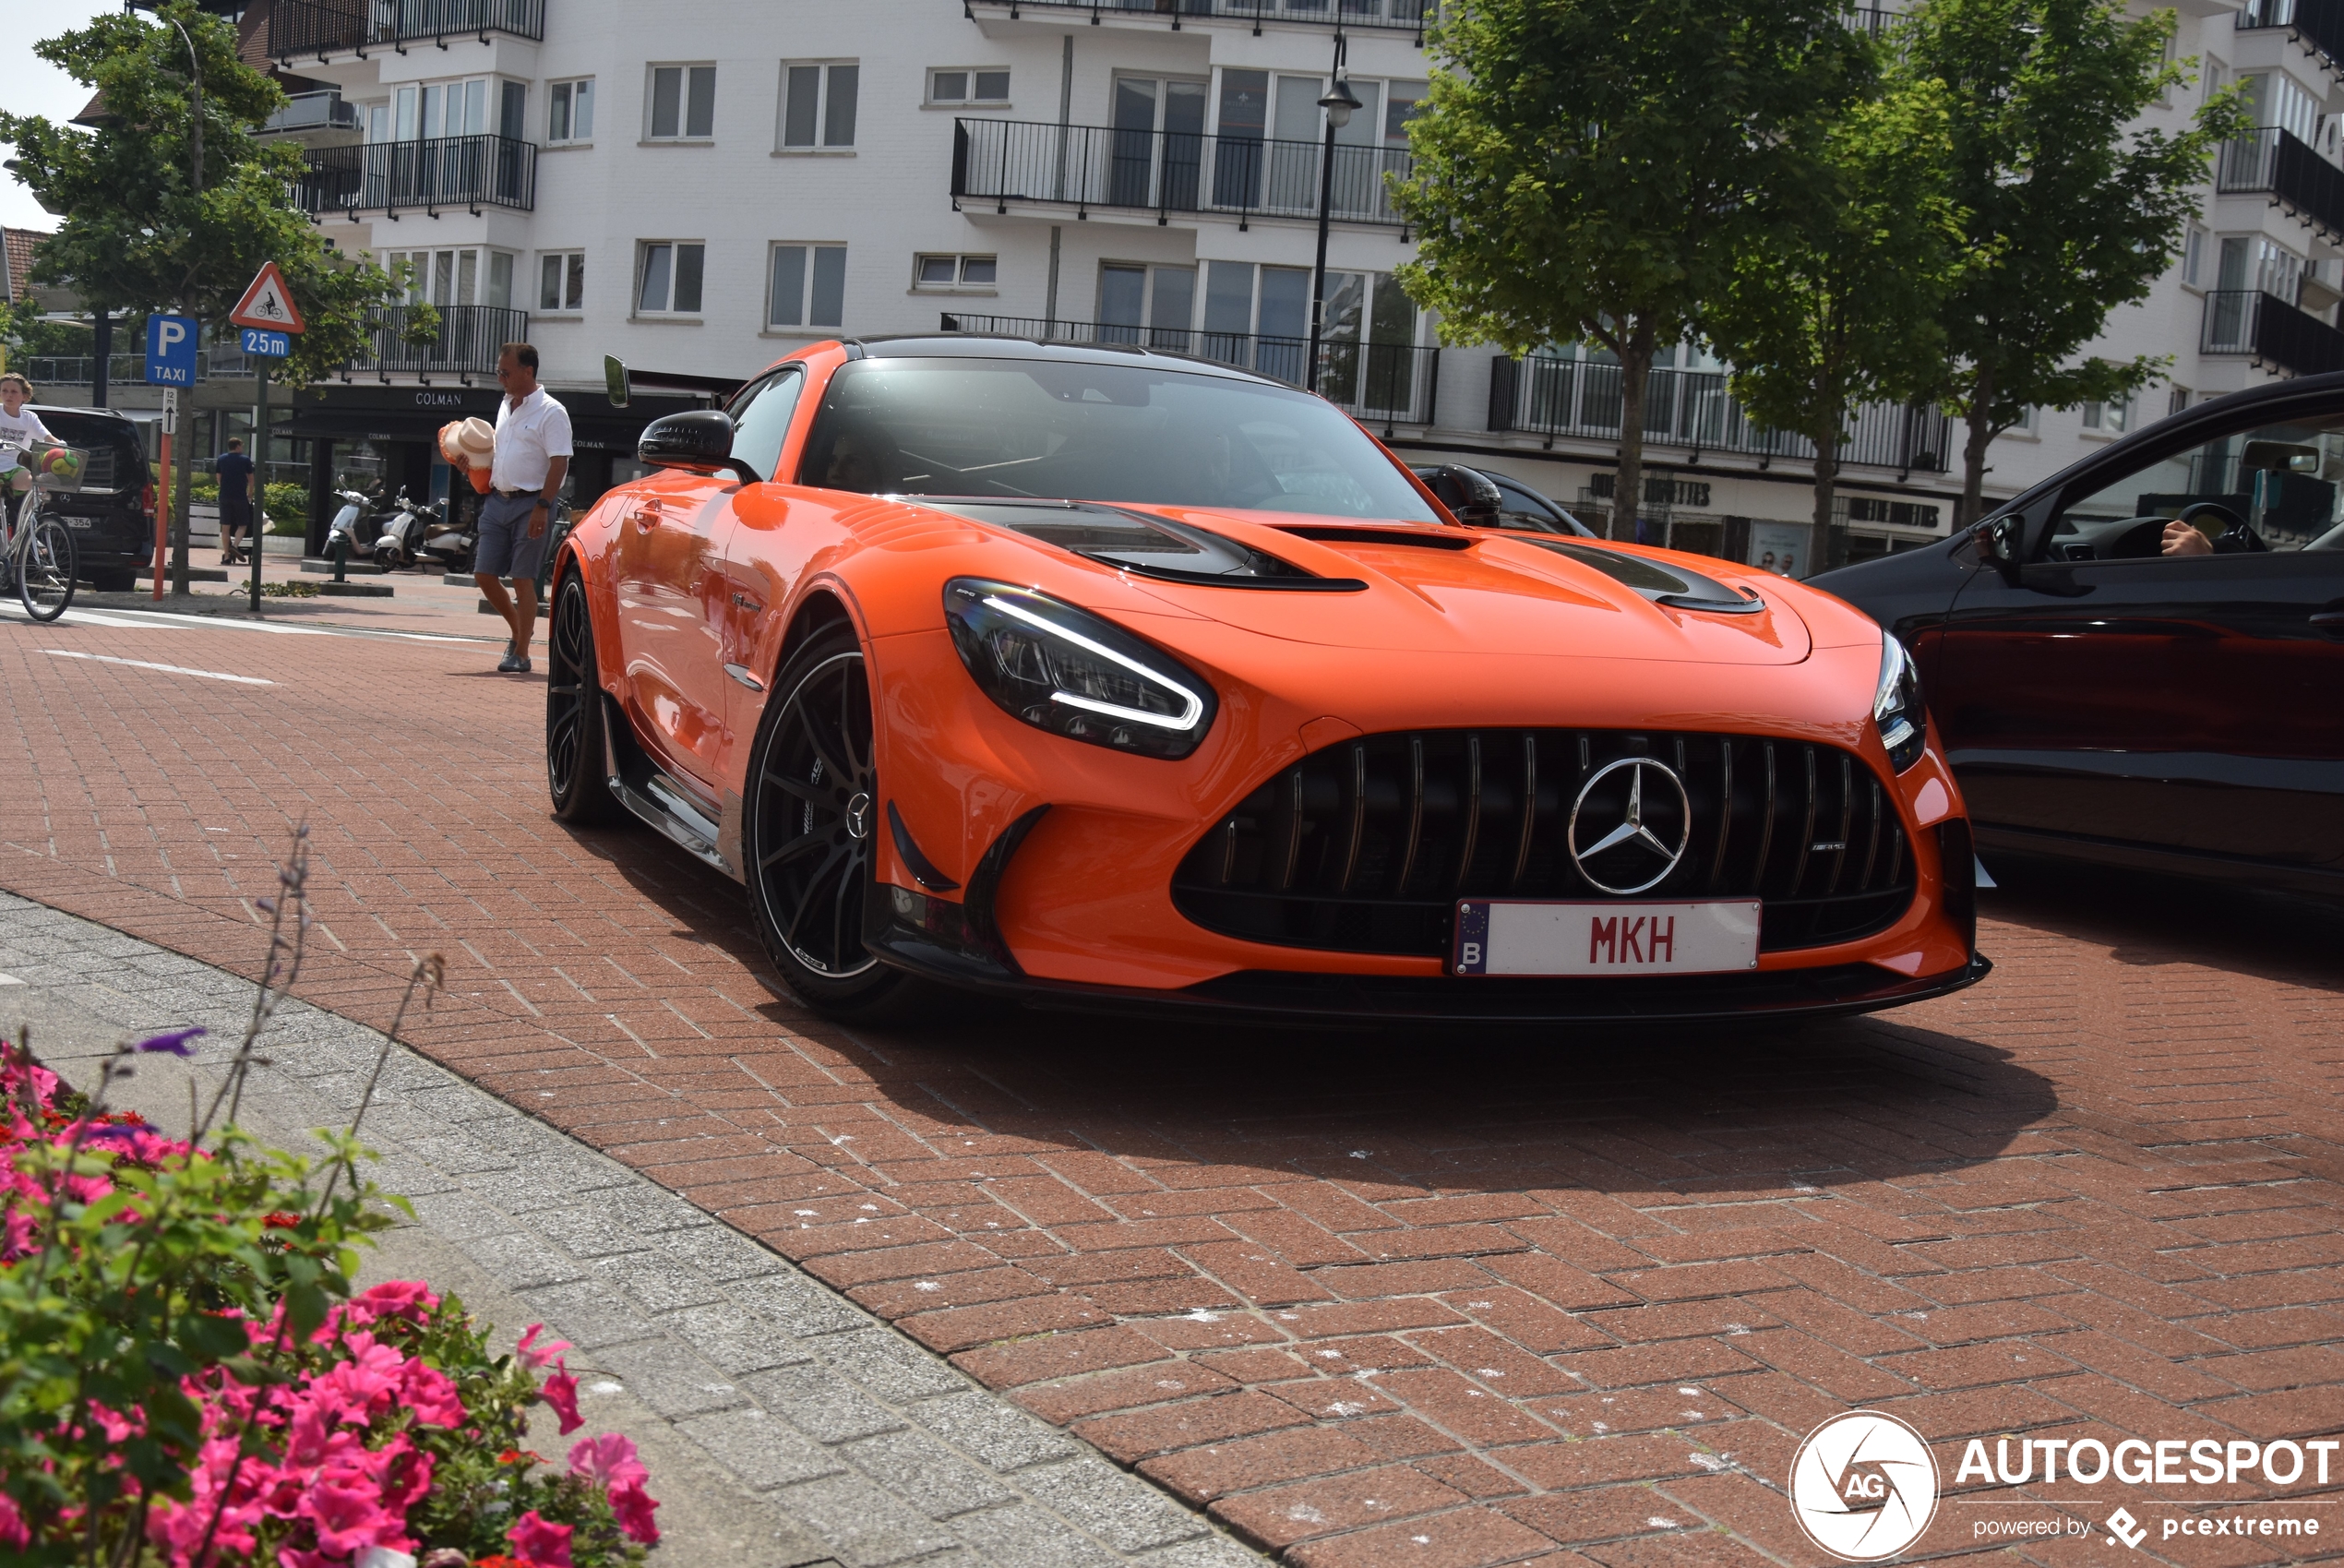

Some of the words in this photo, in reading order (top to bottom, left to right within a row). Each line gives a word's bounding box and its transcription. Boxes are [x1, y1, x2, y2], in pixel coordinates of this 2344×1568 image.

[158, 320, 185, 357] P
[247, 331, 285, 355] 25m
[154, 365, 185, 381] TAXI
[166, 390, 174, 399] 12
[415, 392, 461, 405] COLMAN
[572, 439, 604, 449] COLMAN
[1590, 916, 1675, 964] MKH
[1462, 942, 1481, 964] B
